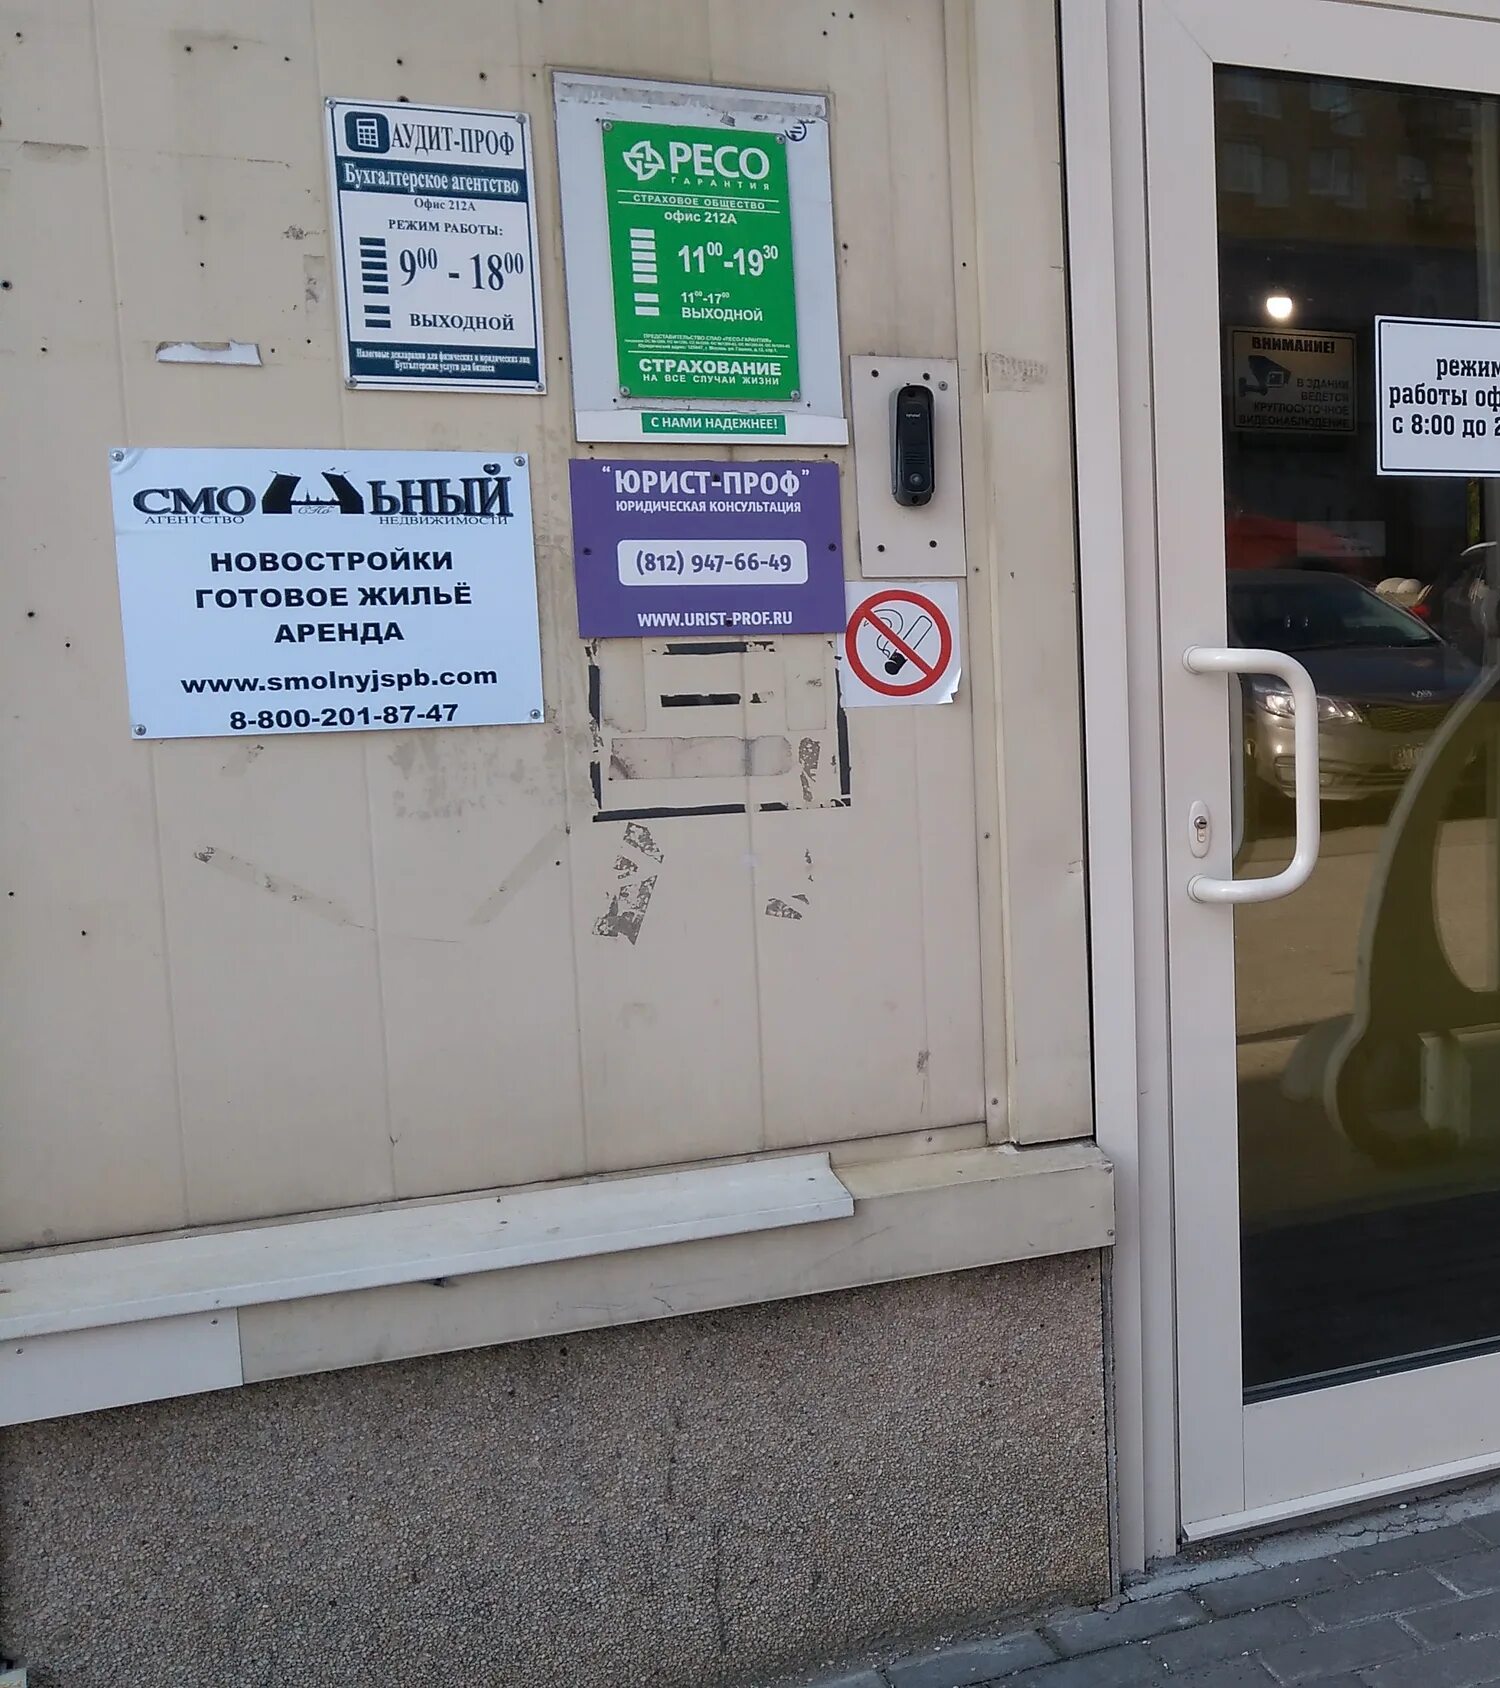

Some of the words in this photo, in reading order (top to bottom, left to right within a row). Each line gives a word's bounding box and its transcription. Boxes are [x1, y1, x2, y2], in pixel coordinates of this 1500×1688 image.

[390, 122, 515, 157] АУДИТ-ПРОФ
[669, 141, 770, 180] РЕСО
[344, 162, 449, 194] Бухгалтерское
[451, 174, 519, 195] агентство
[671, 176, 770, 191] ГАРАНТИЯ
[414, 197, 446, 212] Офис
[633, 193, 699, 206] СТРАХОВОЕ
[703, 198, 766, 211] ОБЩЕСТВО
[388, 218, 440, 233] РЕЖИМ
[444, 222, 503, 237] РАБОТЫ:
[664, 211, 701, 225] офис
[409, 312, 515, 334] ВЫХОДНОЙ
[681, 306, 764, 322] ВЫХОДНОЙ
[1252, 336, 1335, 354] ВНИМАНИЕ!
[639, 358, 782, 377] СТРАХОВАНИЕ
[643, 373, 658, 383] НА
[665, 374, 686, 383] ВСЕ
[693, 375, 736, 385] СЛУЧАИ
[742, 376, 780, 386] ЖИЗНИ
[1388, 383, 1468, 410] работы
[651, 416, 660, 429] С
[662, 416, 703, 429] НАМИ
[704, 417, 778, 431] НАДЕЖНЕЕ!
[1392, 416, 1403, 434] с
[1411, 414, 1455, 436] 8:00
[1462, 417, 1487, 439] до
[616, 500, 707, 514] ЮРИДИЧЕСКАЯ
[709, 501, 801, 515] КОНСУЛЬТАЦИЯ
[144, 515, 245, 526] АГЕНТСТВО
[379, 515, 509, 527] НЕДВИЖИМОСТИ
[209, 546, 454, 573] НОВОСТРОЙКИ
[636, 549, 685, 576] (812)
[691, 553, 792, 573] 947-66-49
[195, 587, 349, 609] ГОТОВОЕ
[359, 584, 473, 607] ЖИЛЬЁ
[637, 611, 793, 628] WWW.URIST-PROF.RU
[274, 621, 405, 646] АРЕНДА
[180, 668, 498, 695] www.smolnyjspb.com
[229, 703, 460, 730] 8-800-201-87-47
